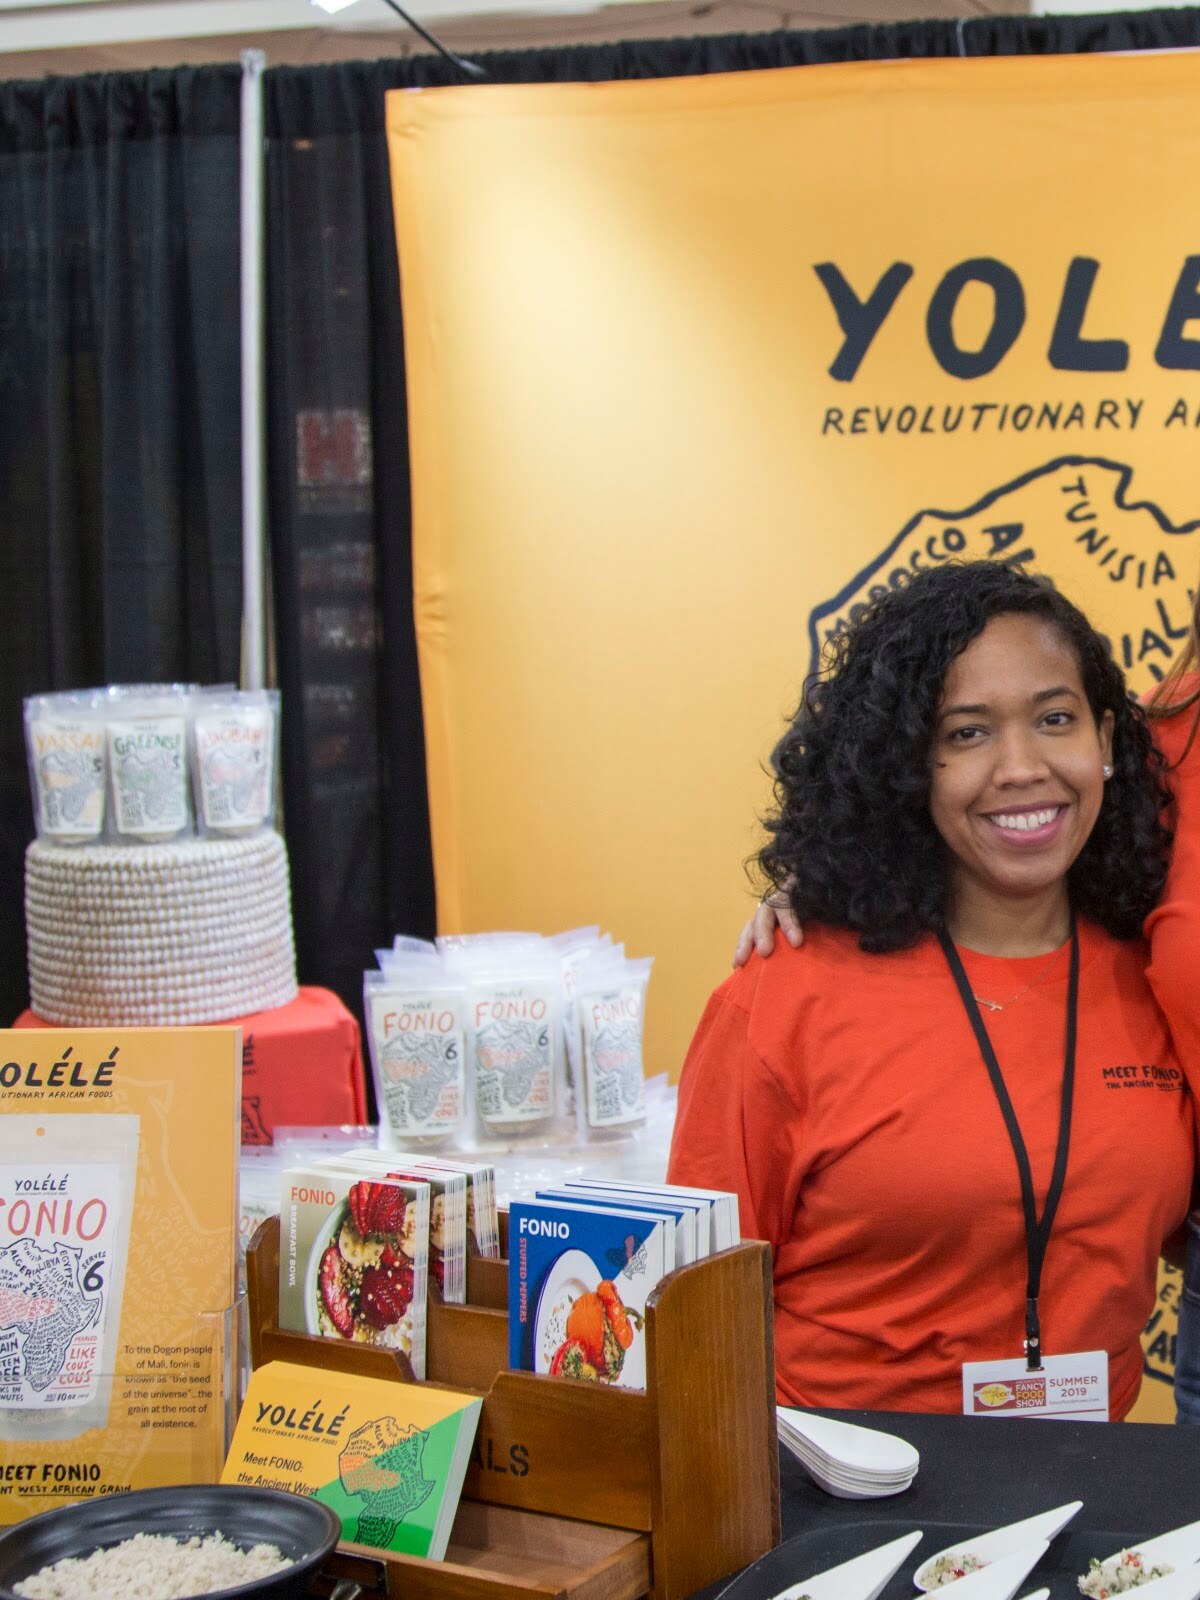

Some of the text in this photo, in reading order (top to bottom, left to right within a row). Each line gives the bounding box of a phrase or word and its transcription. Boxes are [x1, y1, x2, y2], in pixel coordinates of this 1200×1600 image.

[821, 398, 1144, 436] REVOLUTIONARY
[1061, 476, 1177, 589] TUNISIA
[475, 999, 547, 1028] FONIO
[383, 1011, 455, 1040] FONIO
[538, 1029, 549, 1046] 6
[445, 1042, 457, 1060] 6
[0, 1046, 119, 1088] OLÉLÉ
[1102, 1065, 1180, 1081] MEET FONIO
[1, 1091, 45, 1099] UTIONARY
[15, 1173, 69, 1191] YOLÉLÉ
[291, 1187, 335, 1206] FONIO
[520, 1217, 570, 1239] FONIO
[38, 1257, 61, 1271] LIBYA
[60, 1250, 73, 1279] EGYPT
[81, 1250, 107, 1270] SERVES
[83, 1260, 105, 1292] 6
[519, 1237, 527, 1323] STUFFED PEPPERS
[70, 1347, 97, 1360] LIKE
[124, 1345, 135, 1353] To
[136, 1345, 151, 1353] the
[153, 1345, 181, 1356] Dogon
[65, 1361, 94, 1371] COUS-
[136, 1360, 145, 1368] of
[59, 1370, 93, 1384] COUS
[189, 1374, 211, 1383] seed
[1049, 1376, 1098, 1387] SUMMER
[123, 1390, 132, 1398] of
[134, 1390, 149, 1398] the
[1015, 1382, 1045, 1391] FANCY
[1015, 1390, 1045, 1399] FOOD
[1061, 1387, 1087, 1397] 2019
[57, 1393, 67, 1401] 10
[1016, 1399, 1044, 1408] SHOW
[127, 1404, 208, 1415] grain at the root of
[256, 1399, 350, 1436] YOLÉLÉ
[140, 1420, 197, 1428] all existence.
[252, 1426, 295, 1438] REVOLUTIONARY
[297, 1434, 320, 1443] AFRICAN
[243, 1452, 304, 1472] Meet FONIO:
[42, 1464, 101, 1481] FONIO
[18, 1485, 48, 1493] WEST
[51, 1485, 96, 1494] AFRICAN
[100, 1484, 131, 1494] GRAIN
[237, 1472, 319, 1497] the Ancient West
